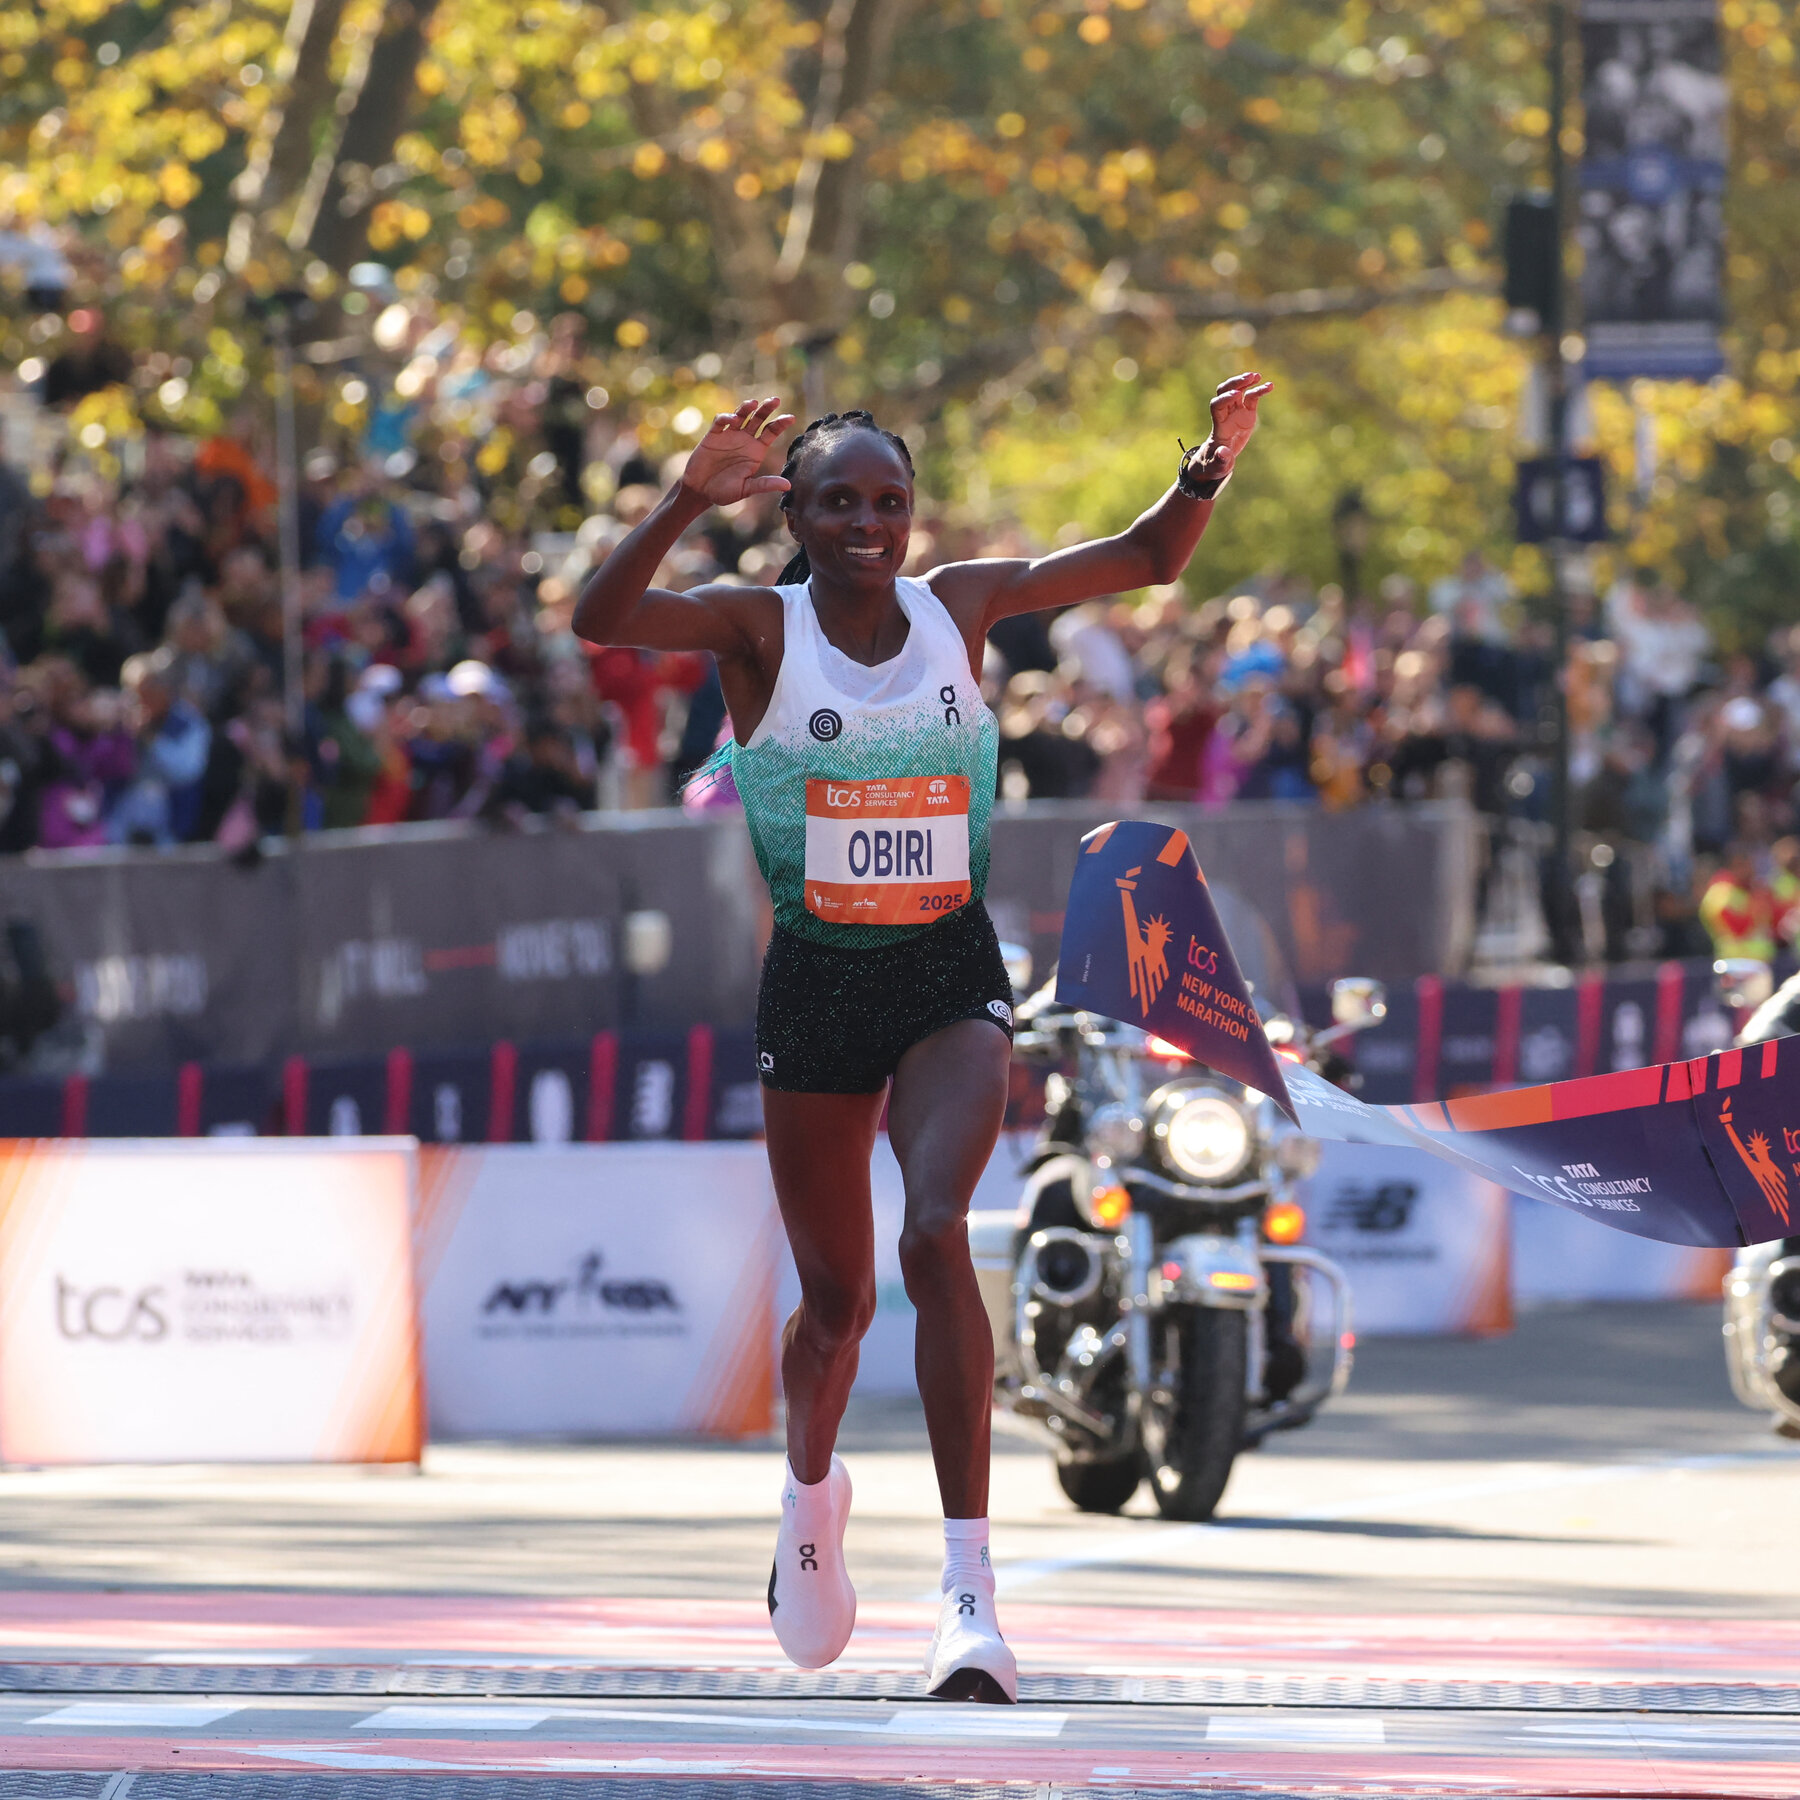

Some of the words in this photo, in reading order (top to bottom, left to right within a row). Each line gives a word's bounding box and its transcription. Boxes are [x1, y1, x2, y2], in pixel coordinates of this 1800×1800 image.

[826, 784, 861, 807] tcs
[864, 799, 898, 807] SERVICES
[865, 791, 915, 799] CONSULTANCY
[926, 795, 950, 805] TATA
[848, 829, 933, 877] OBIRI
[919, 894, 963, 911] 2025
[1187, 934, 1218, 975] tcs
[1181, 972, 1212, 999] NEW
[1215, 988, 1246, 1019] YORK
[1176, 992, 1249, 1042] MARATHON
[1562, 1163, 1600, 1178] TATA
[1577, 1177, 1652, 1195] CONSULTANCY
[1593, 1199, 1640, 1212] SERVICES
[54, 1273, 171, 1341] tcs
